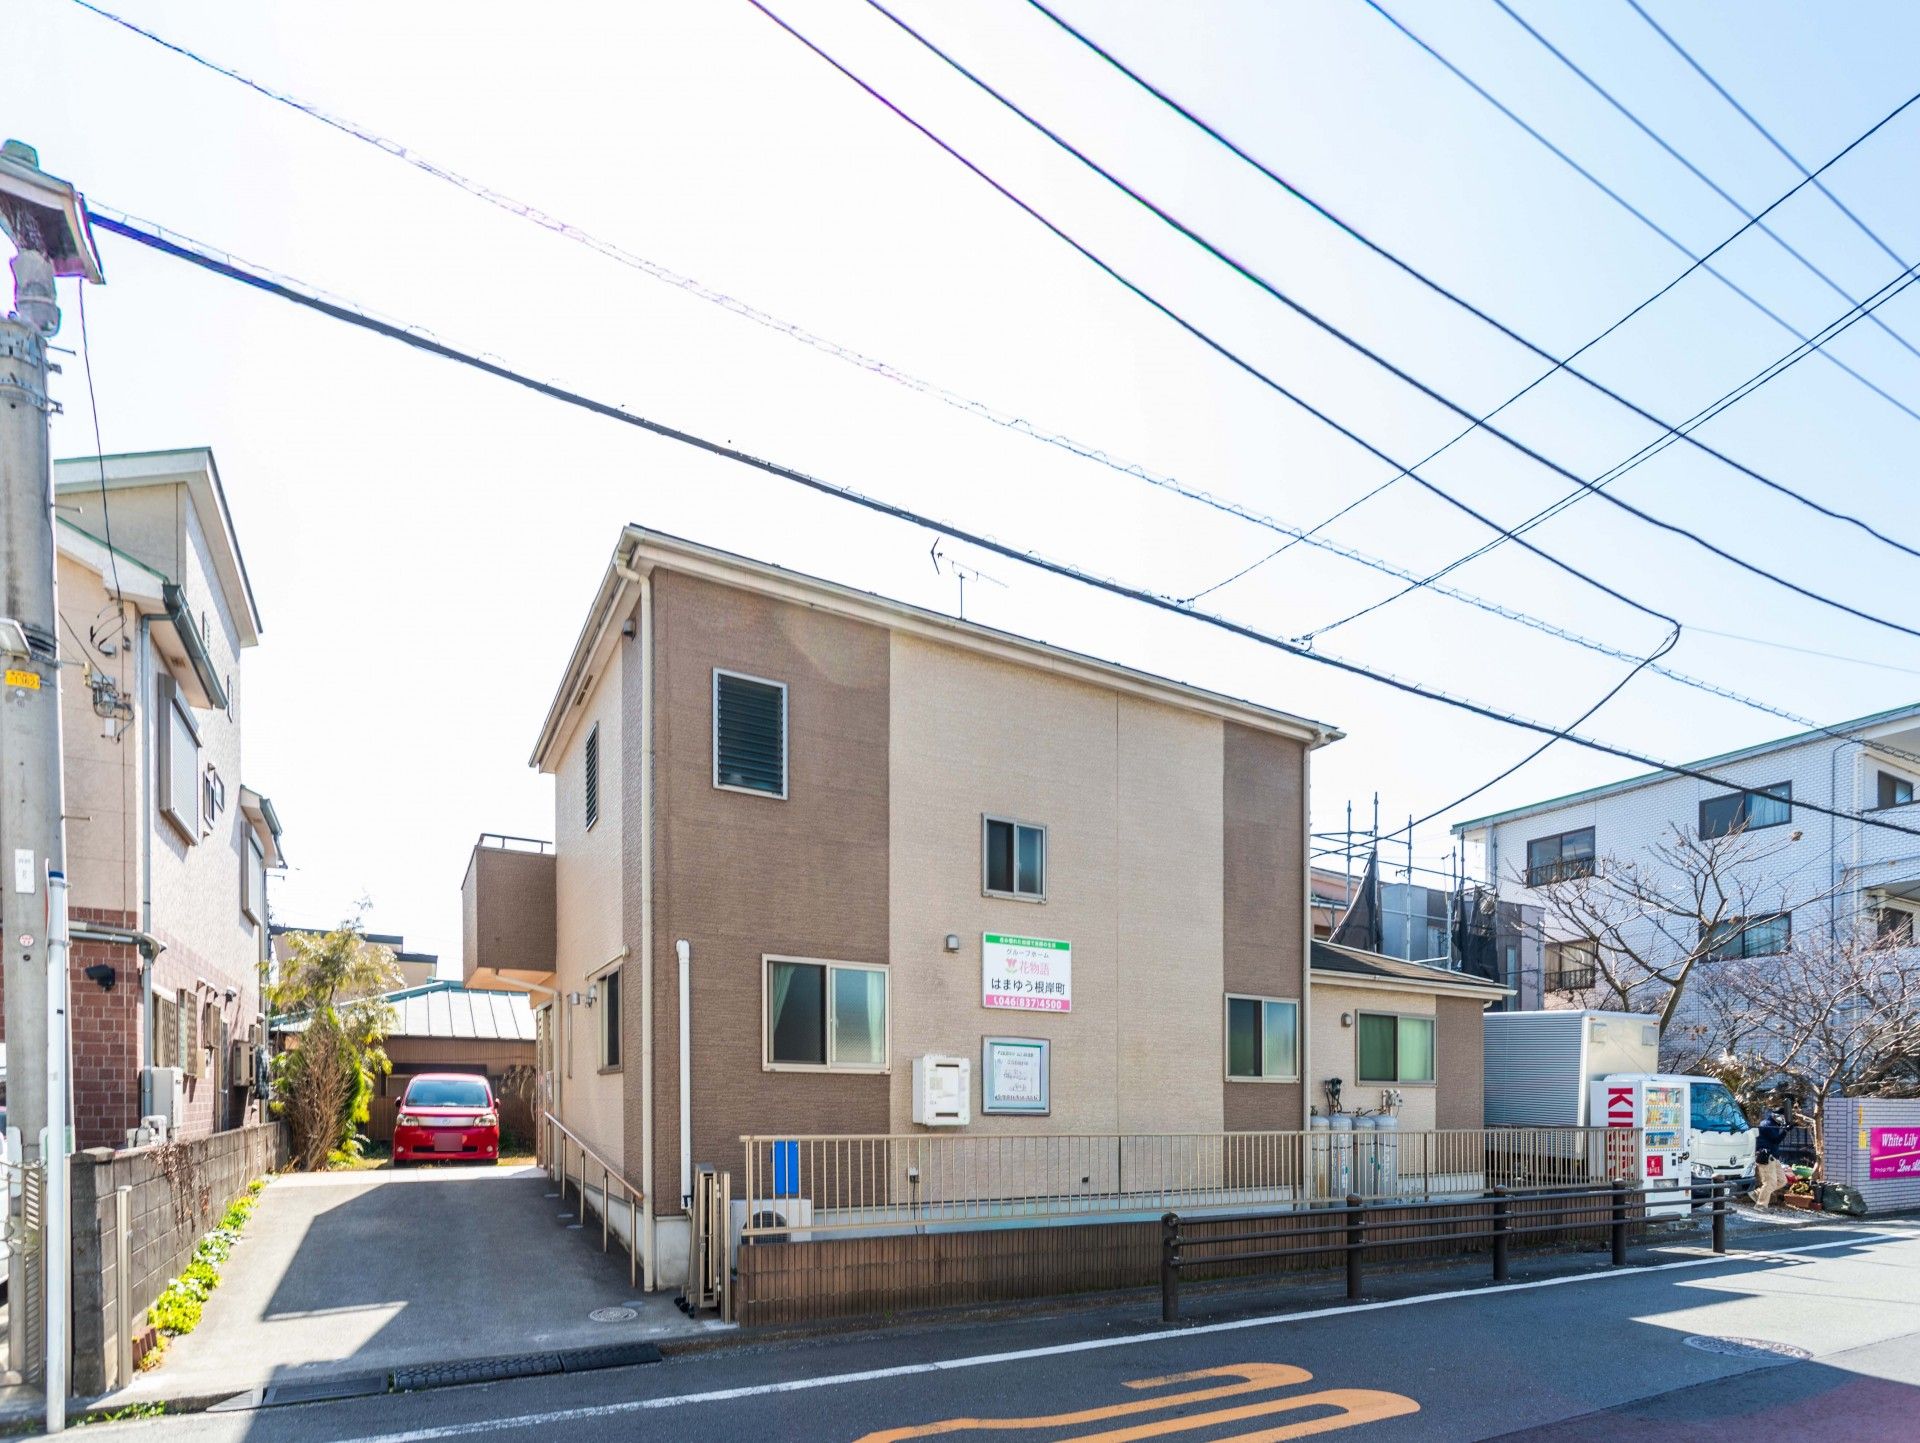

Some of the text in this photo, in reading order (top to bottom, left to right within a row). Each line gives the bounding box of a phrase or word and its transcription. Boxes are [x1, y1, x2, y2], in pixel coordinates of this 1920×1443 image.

[991, 978, 1065, 995] はまゆう根岸町
[1882, 1133, 1903, 1147] White
[1903, 1133, 1918, 1149] Lily
